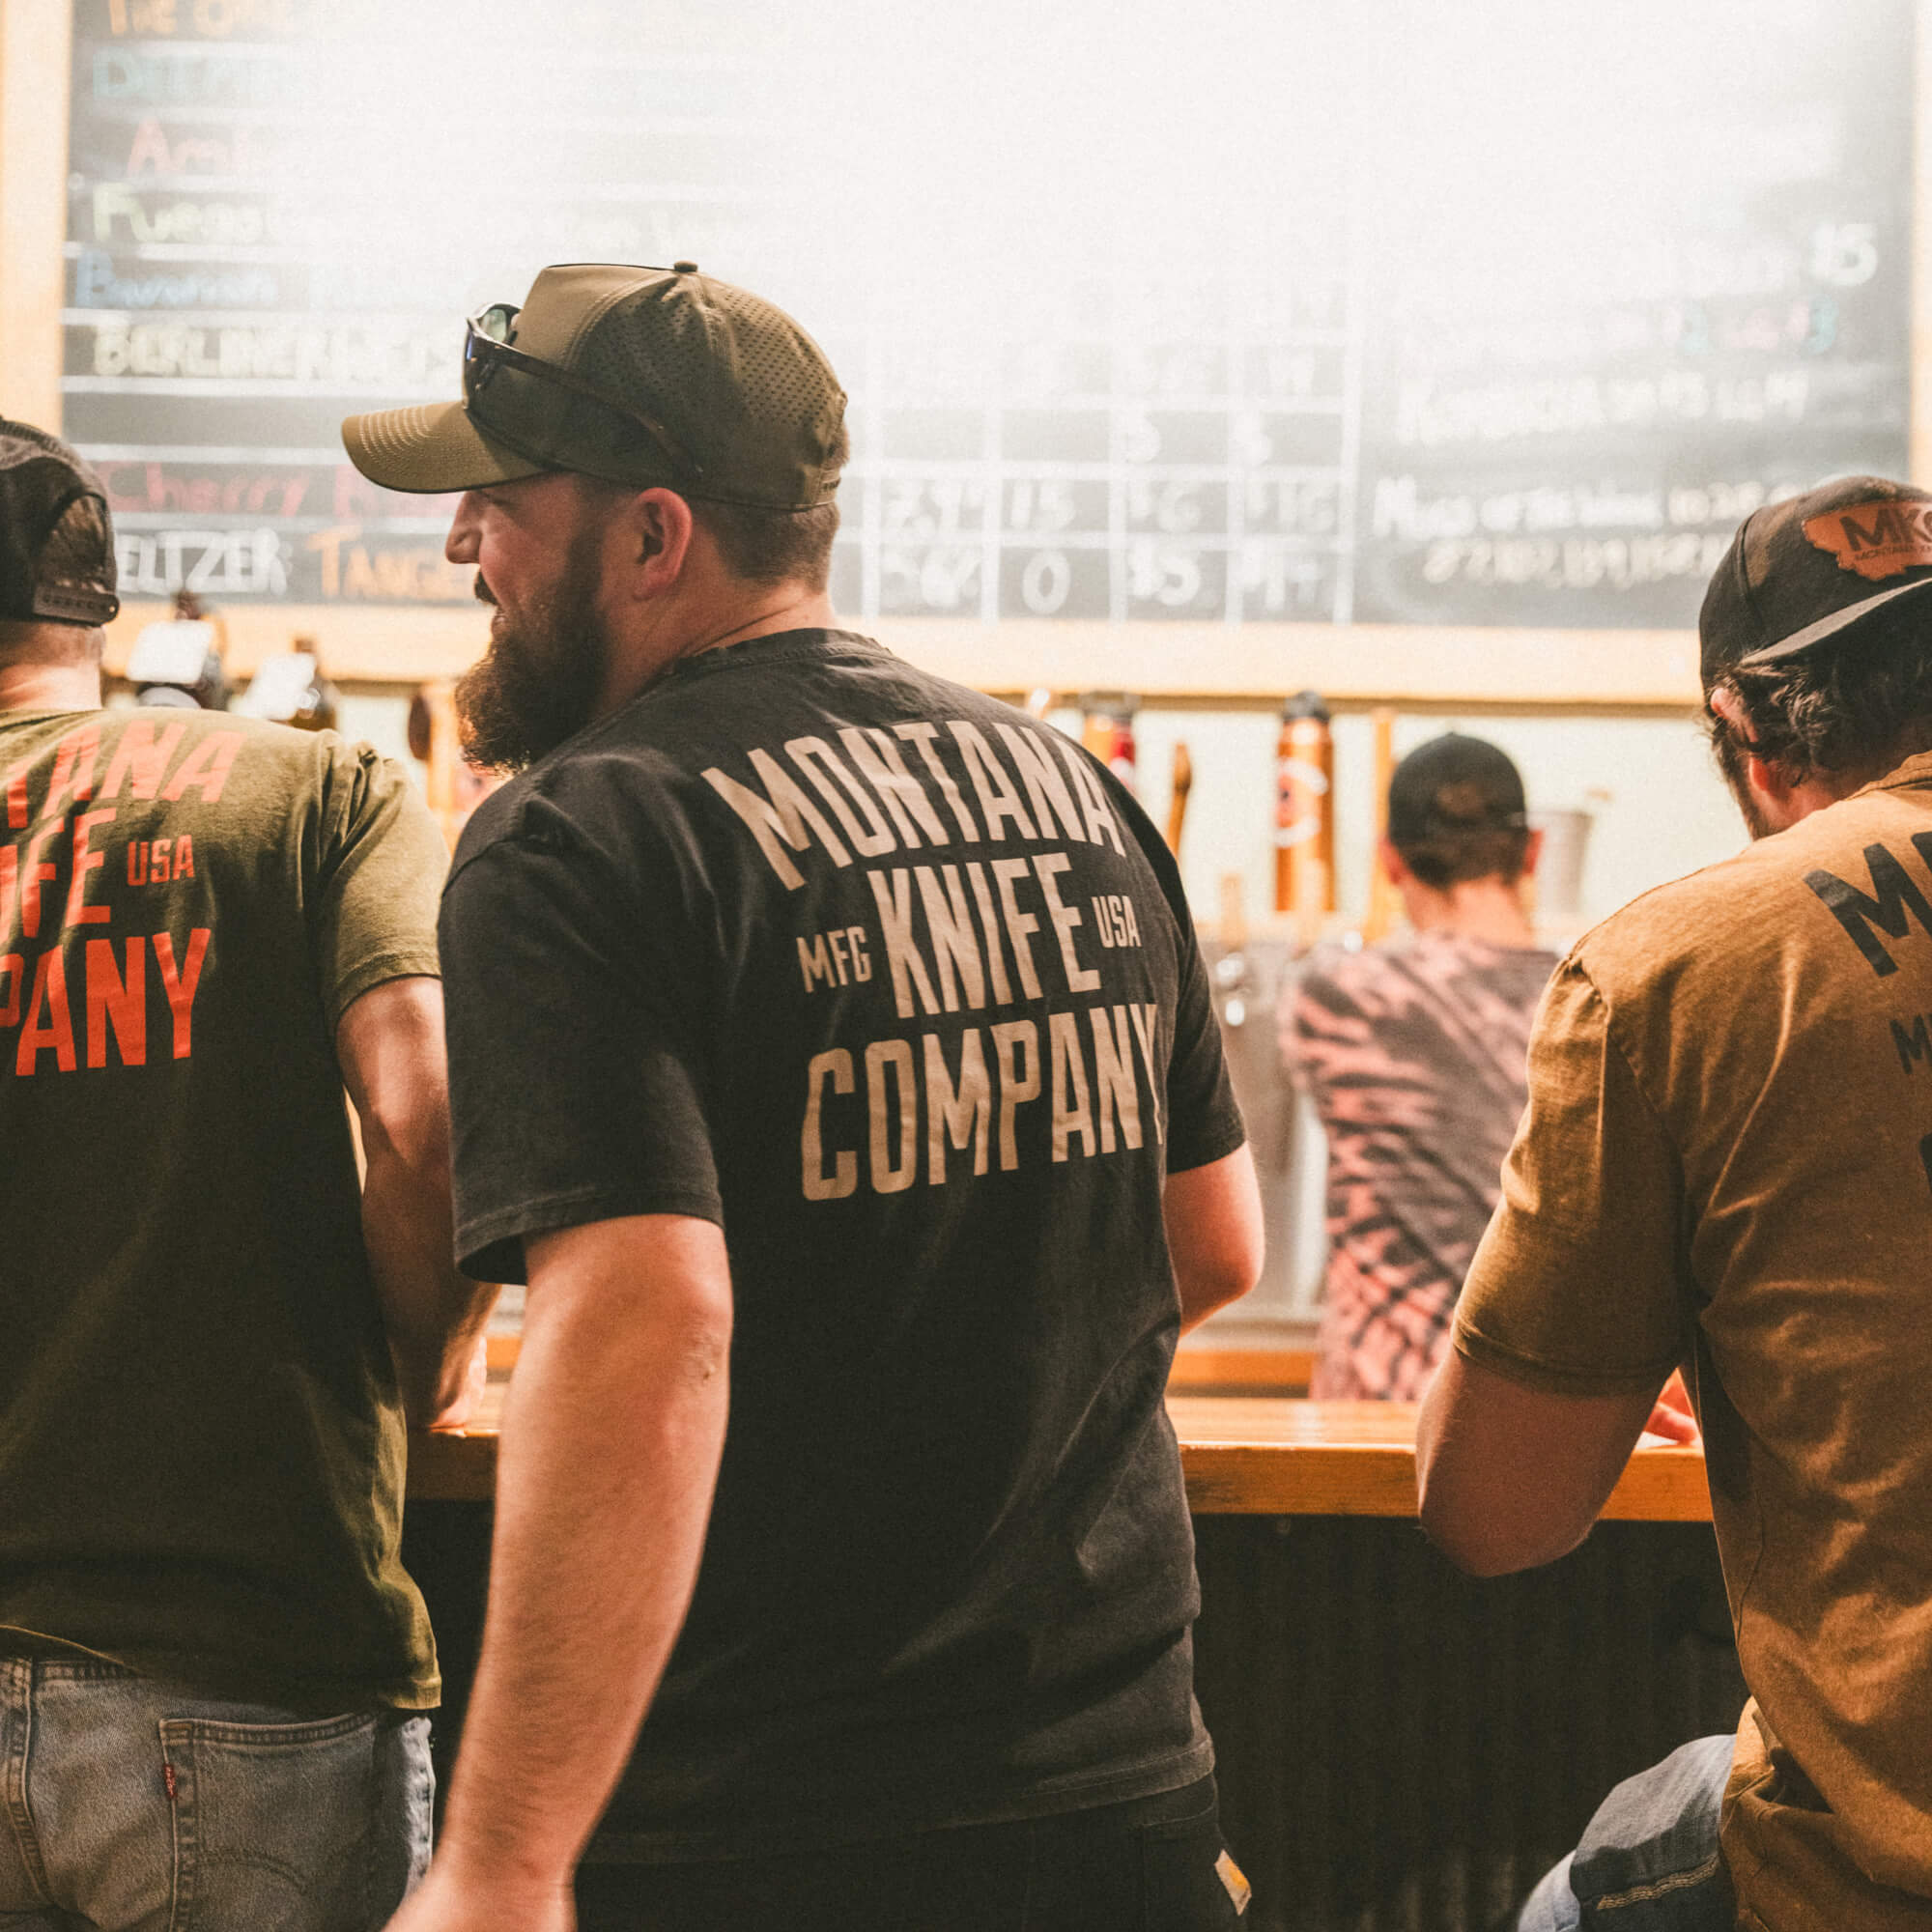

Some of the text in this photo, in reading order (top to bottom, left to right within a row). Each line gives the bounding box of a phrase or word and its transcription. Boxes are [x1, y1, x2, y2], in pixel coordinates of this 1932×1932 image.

[128, 835, 194, 886] USA
[700, 721, 1126, 891] MONTANA
[796, 852, 1142, 1019] MFG KNIFE USA
[801, 1004, 1164, 1201] COMPANY
